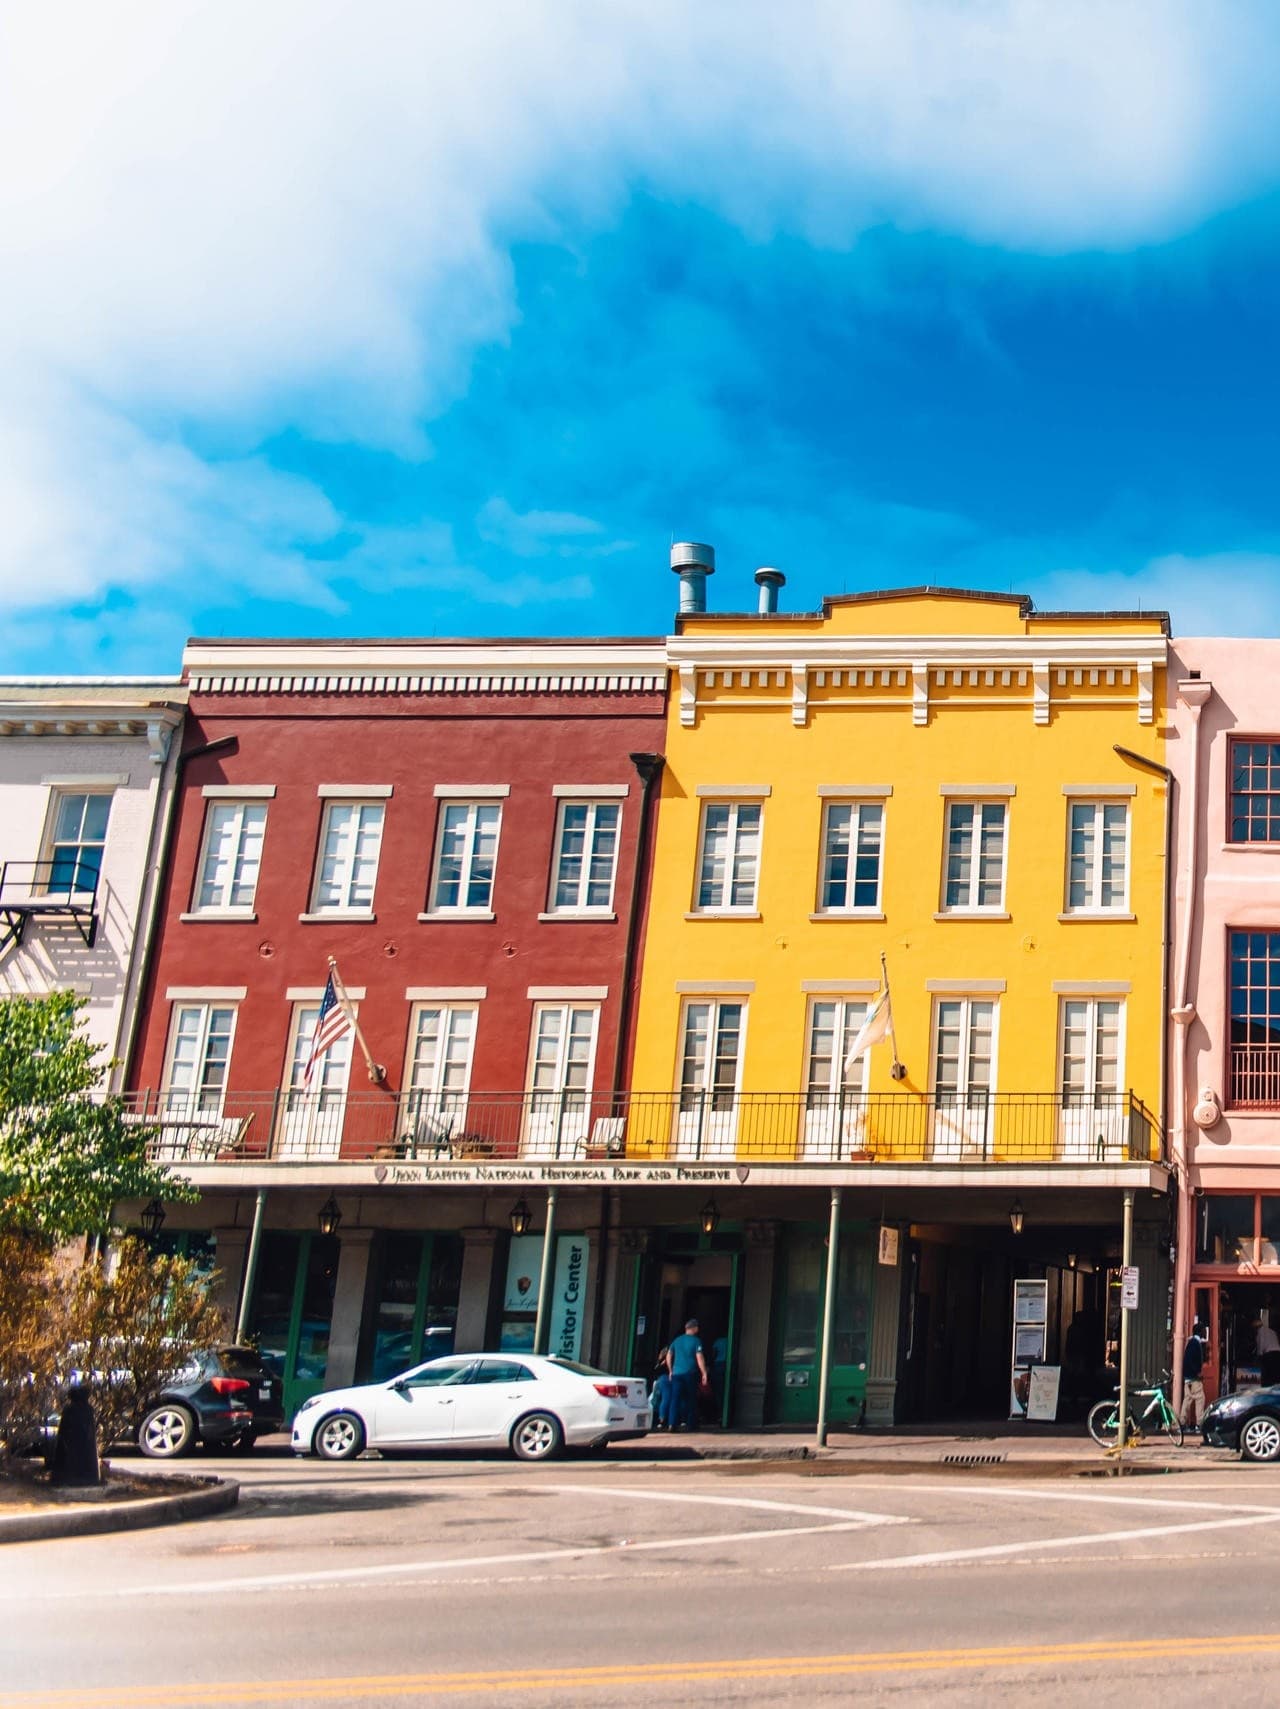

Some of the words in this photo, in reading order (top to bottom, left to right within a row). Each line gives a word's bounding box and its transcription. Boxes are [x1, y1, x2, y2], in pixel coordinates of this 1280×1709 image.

[476, 1167, 534, 1180] NATIONAL
[541, 1167, 606, 1180] HISTORICAL
[612, 1167, 641, 1180] PARK
[646, 1170, 671, 1181] AND
[677, 1168, 731, 1180] PRESERVE
[564, 1245, 582, 1303] Center
